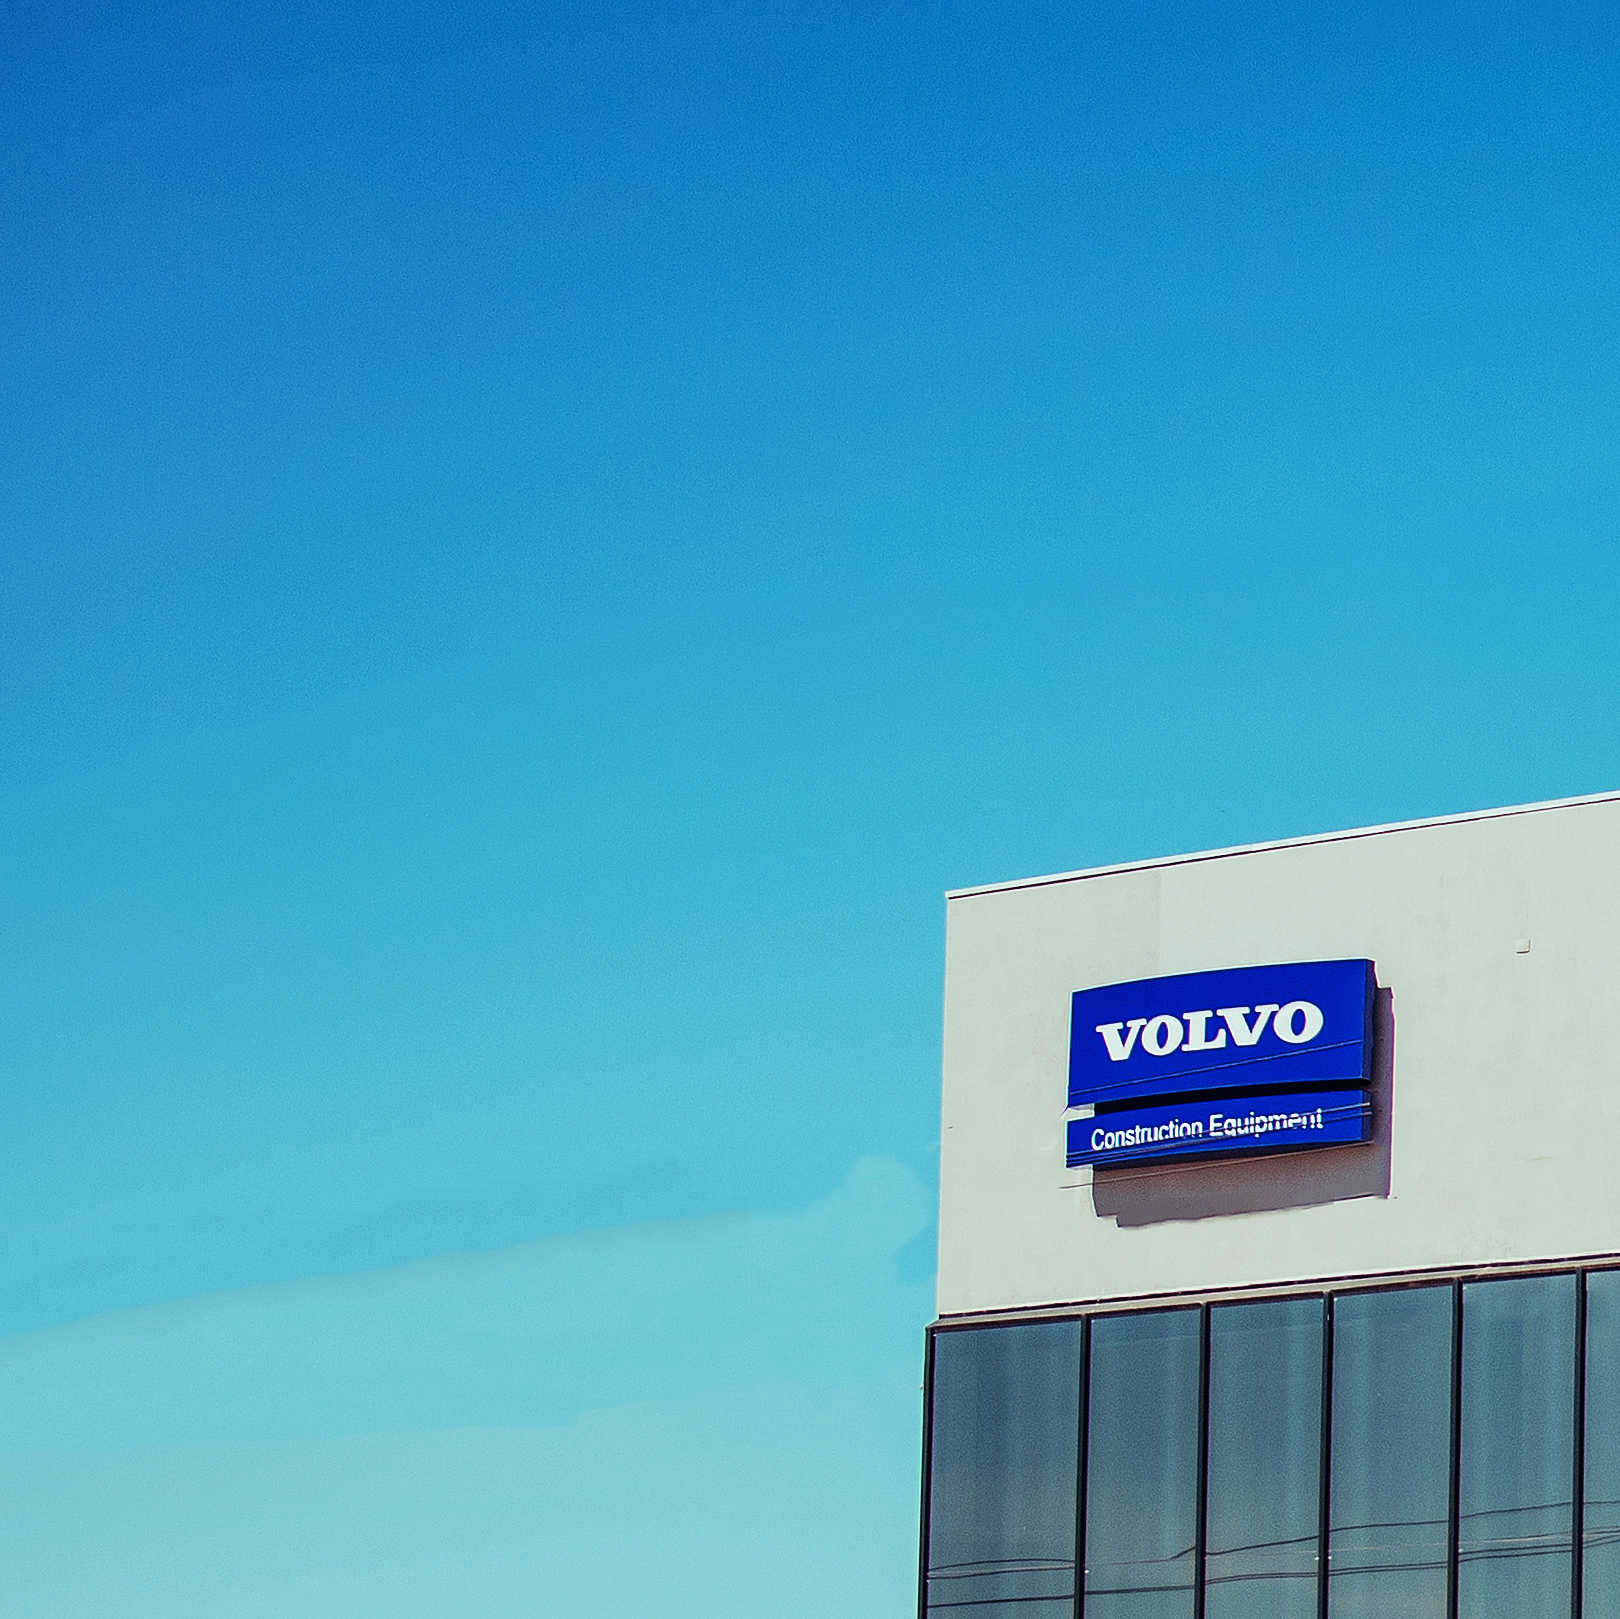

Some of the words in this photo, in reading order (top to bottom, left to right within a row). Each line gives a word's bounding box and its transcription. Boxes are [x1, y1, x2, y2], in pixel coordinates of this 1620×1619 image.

[1095, 1000, 1324, 1061] VOLVO
[1090, 1117, 1203, 1151] Construction
[1209, 1108, 1324, 1139] Equipment
